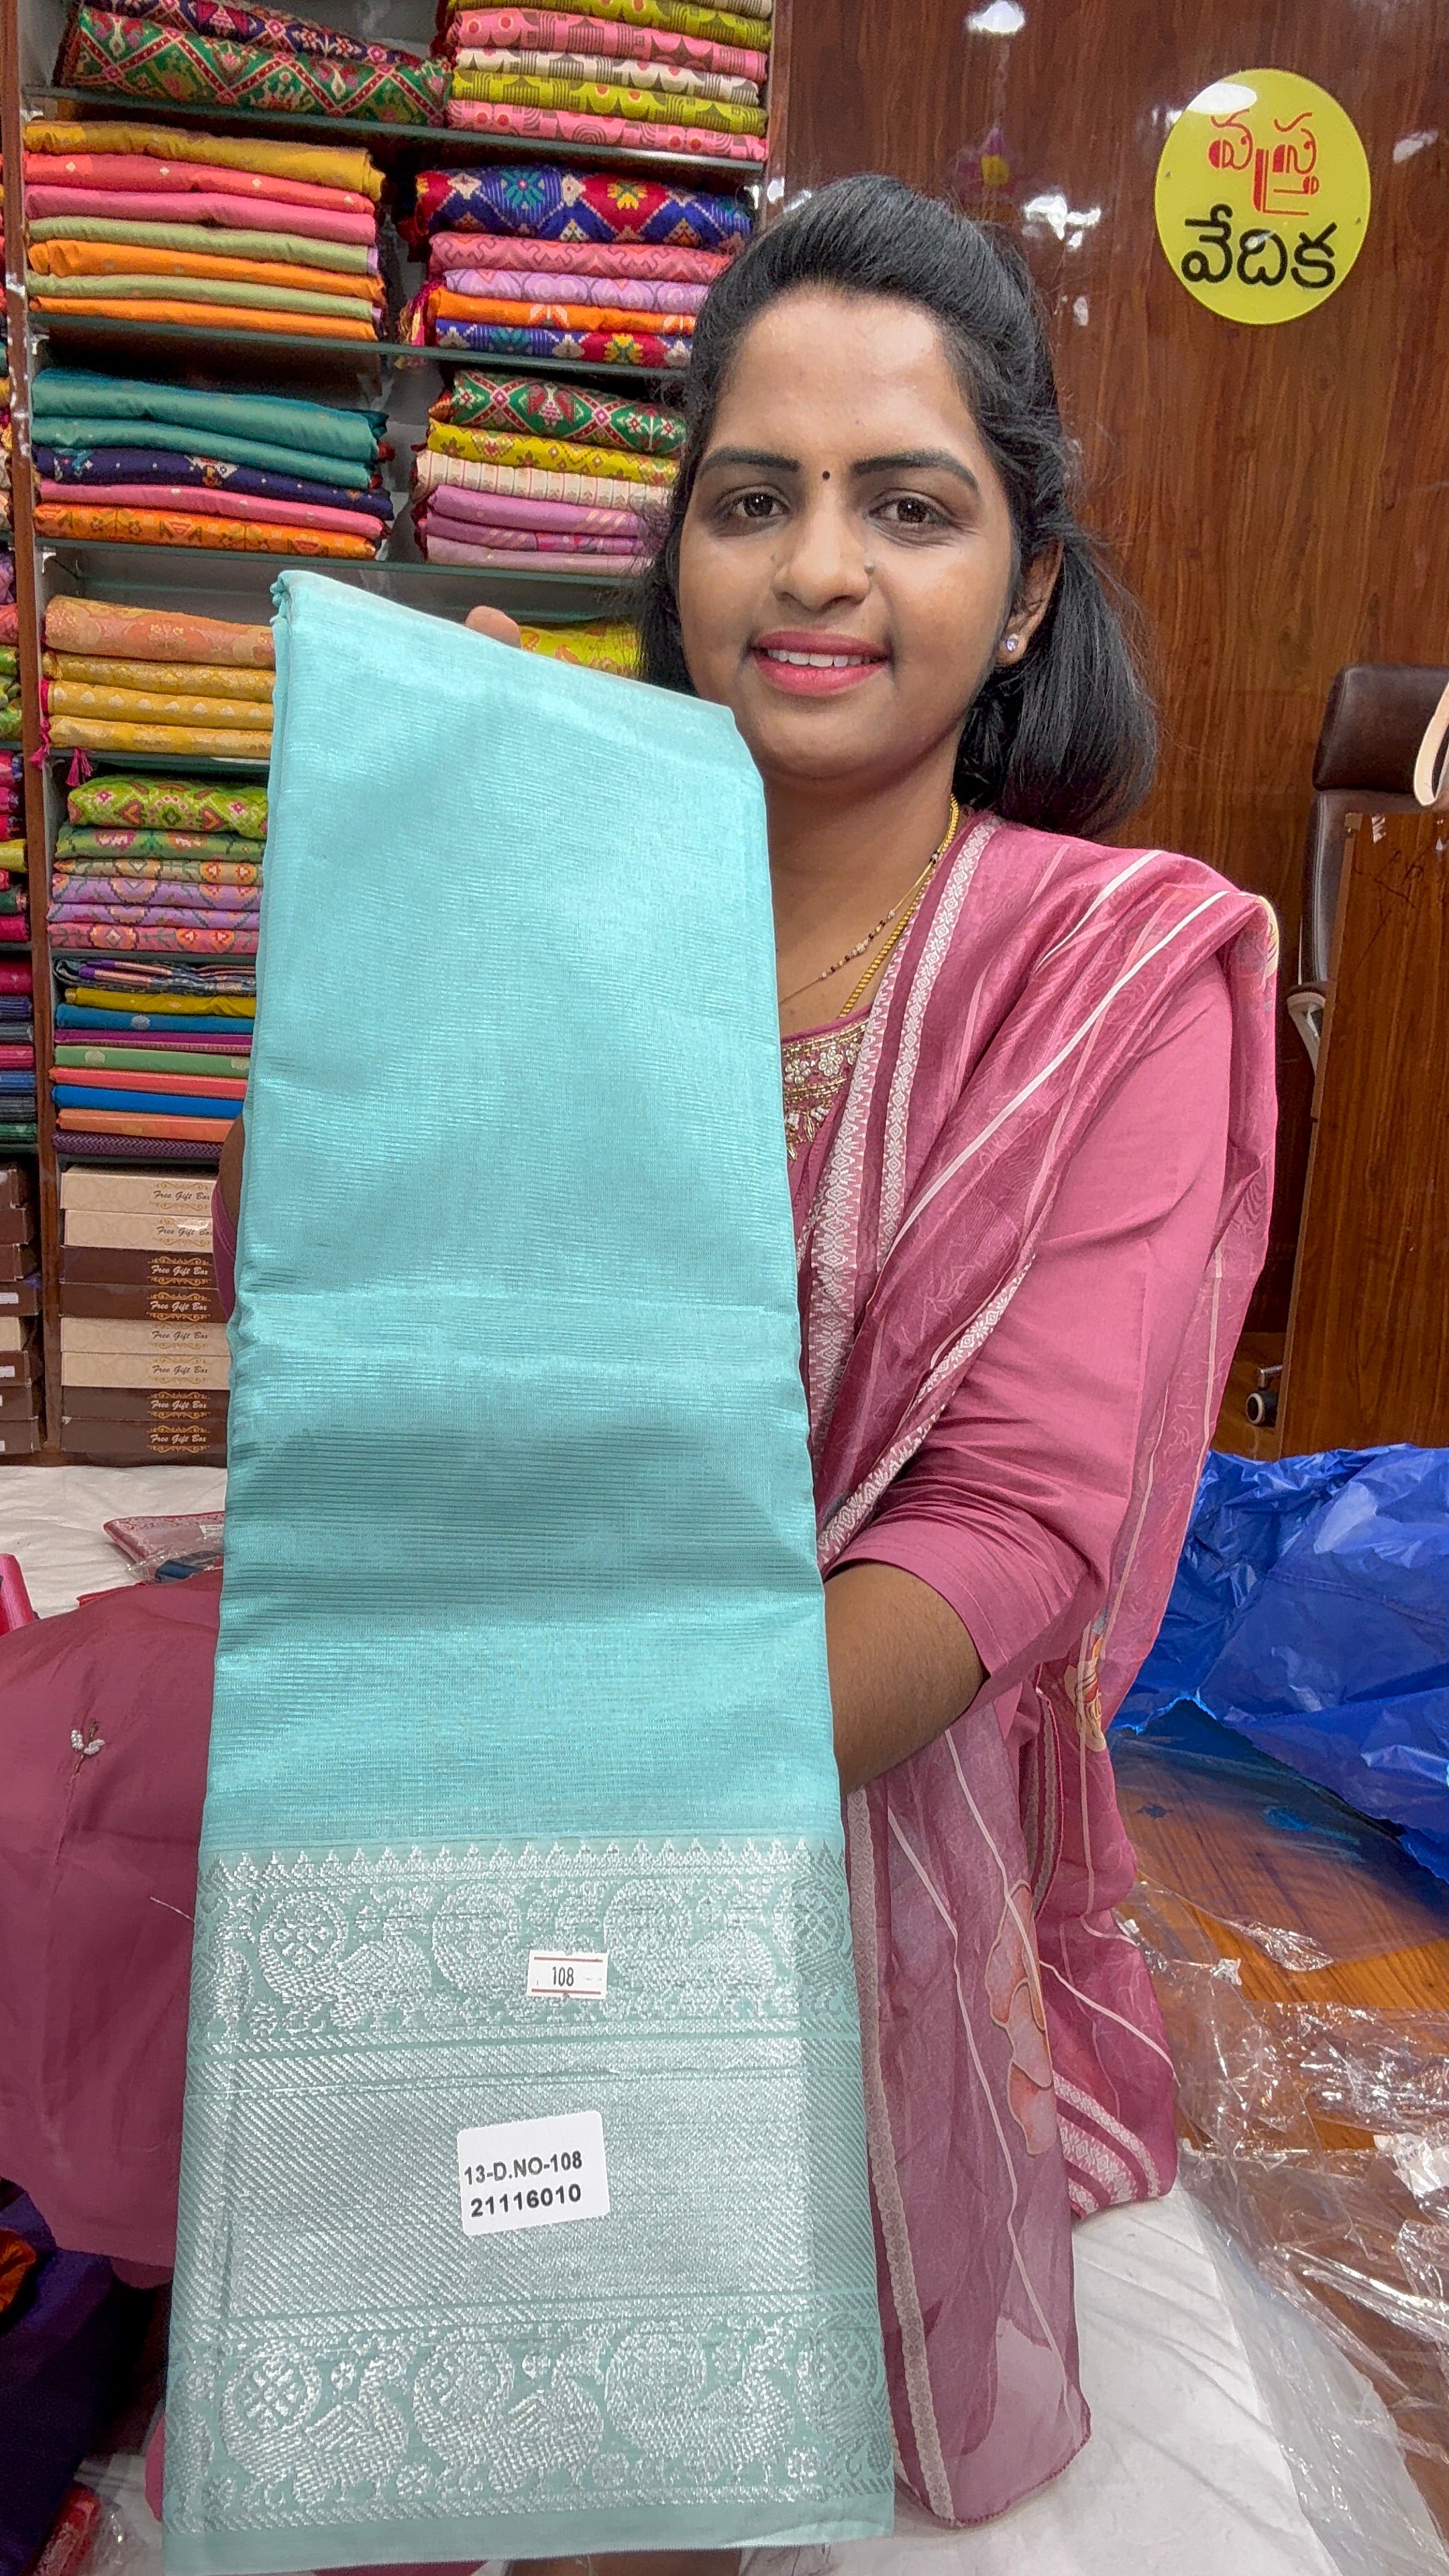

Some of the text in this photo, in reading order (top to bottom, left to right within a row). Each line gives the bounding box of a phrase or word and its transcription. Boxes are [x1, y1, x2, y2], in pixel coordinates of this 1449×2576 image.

[1181, 204, 1338, 288] వేదిక
[153, 1190, 210, 1201] Free Gift Box
[156, 1226, 174, 1234] Free
[178, 1228, 195, 1237] Gift
[151, 1265, 209, 1276] Free Gift Box
[150, 1301, 207, 1312] Free Gift Box
[152, 1331, 170, 1340] Free
[173, 1332, 191, 1341] Gift
[152, 1364, 170, 1374] Free
[173, 1365, 191, 1375] Gift
[150, 1400, 207, 1410] Free Gift Box
[150, 1434, 207, 1444] Free Gift Box
[552, 1966, 574, 1987] 108
[464, 2150, 582, 2185] 13-D.NO-108
[470, 2184, 582, 2218] 21116010
